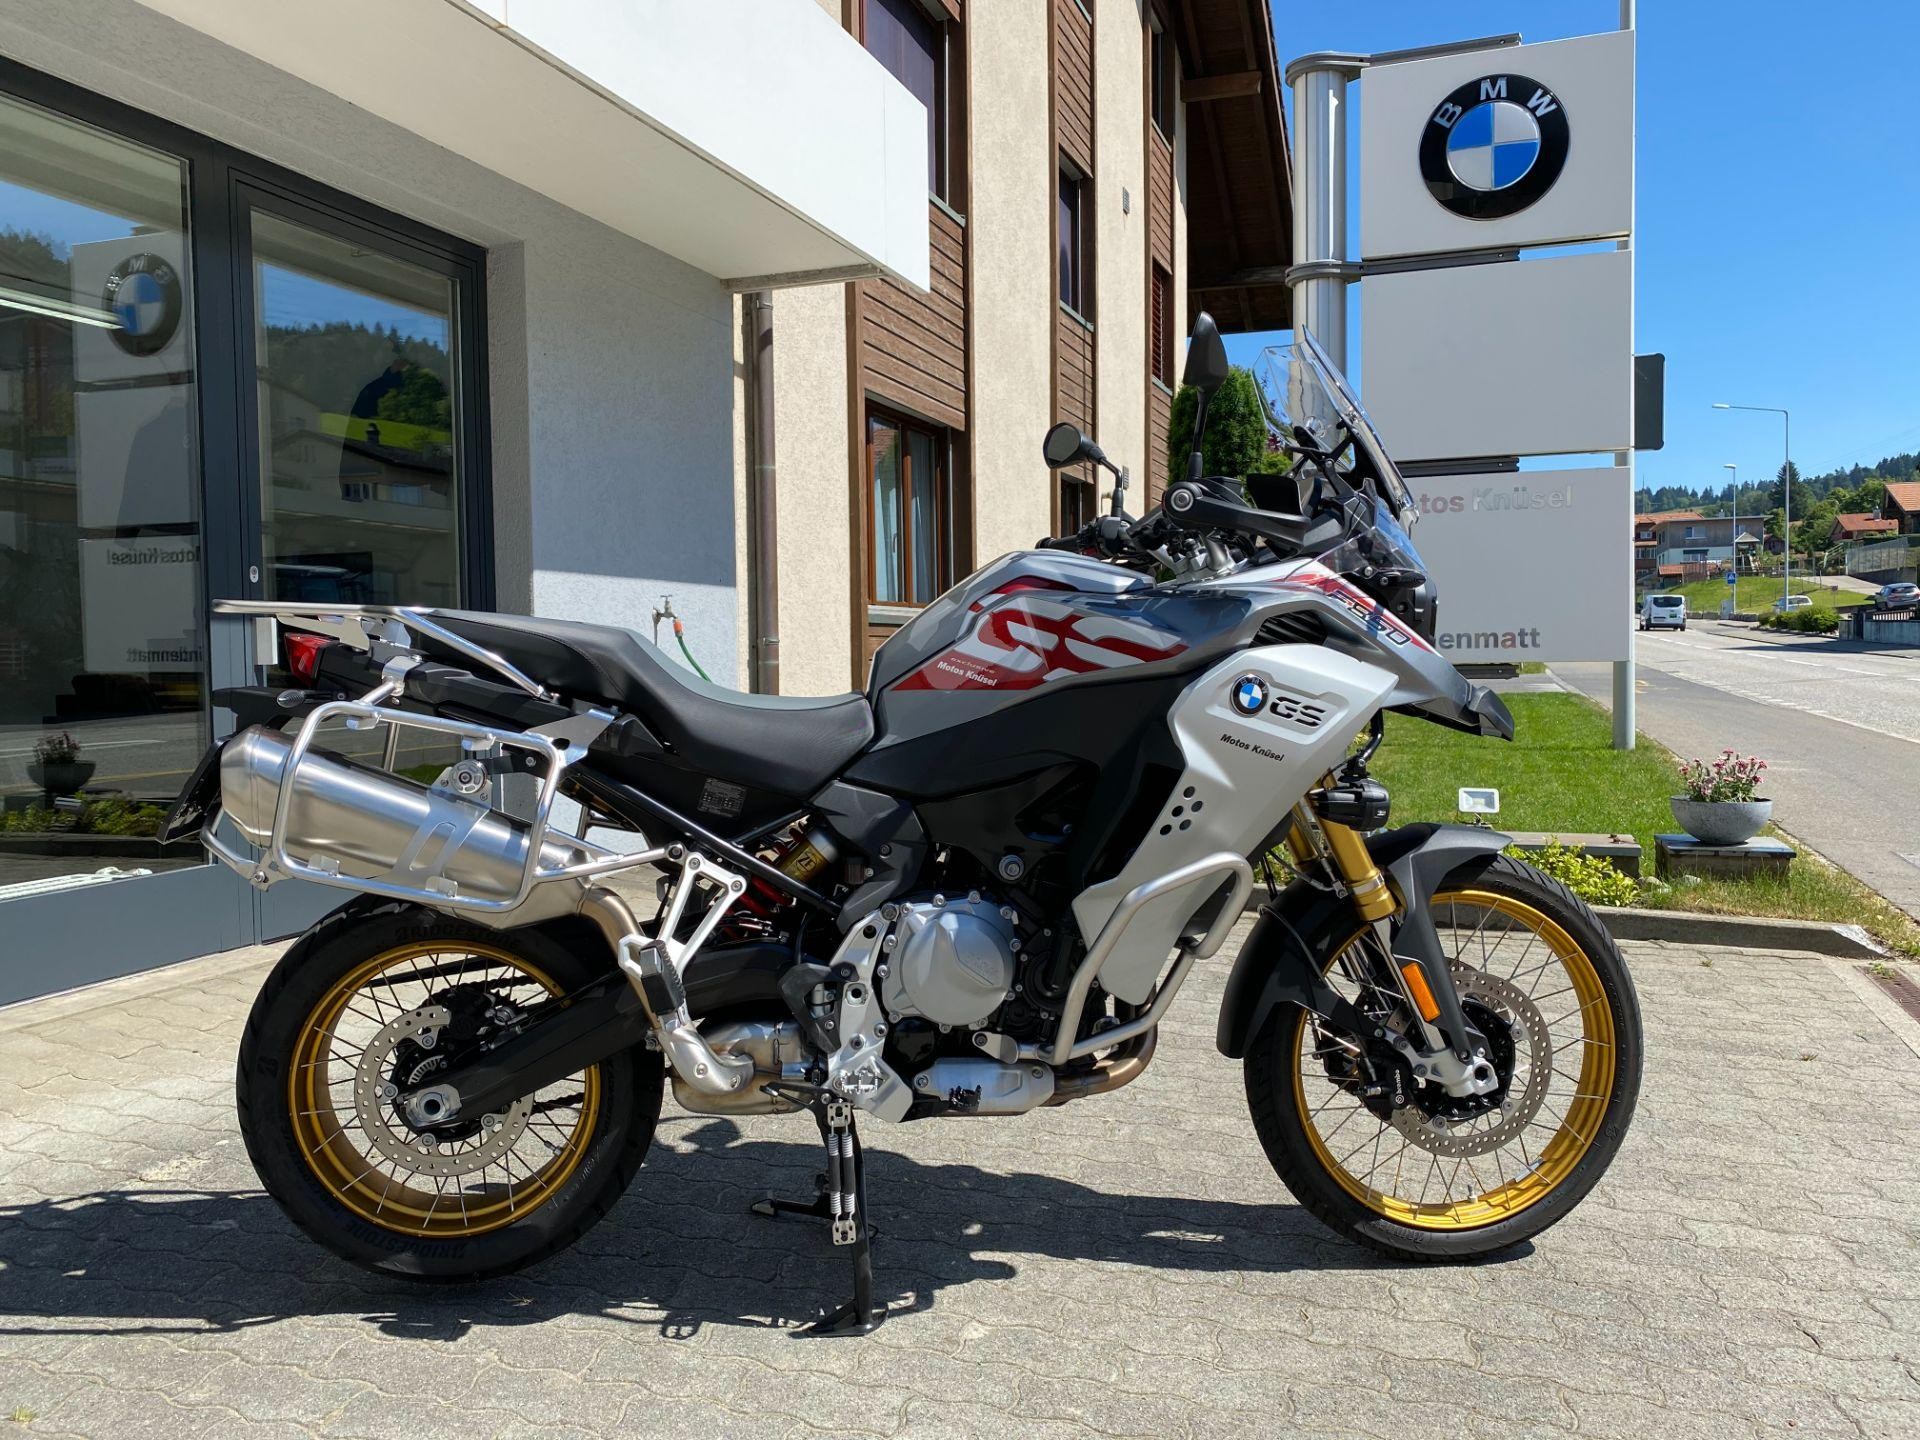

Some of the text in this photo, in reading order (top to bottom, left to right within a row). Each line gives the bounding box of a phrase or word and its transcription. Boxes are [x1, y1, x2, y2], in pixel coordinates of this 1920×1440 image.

[1433, 76, 1558, 129] BMW
[1420, 485, 1574, 514] tos Knüsel
[1439, 627, 1541, 650] enmatt
[937, 661, 998, 687] Motos Knüsel
[1269, 696, 1327, 728] GS
[1220, 733, 1285, 762] Motos Knüsel
